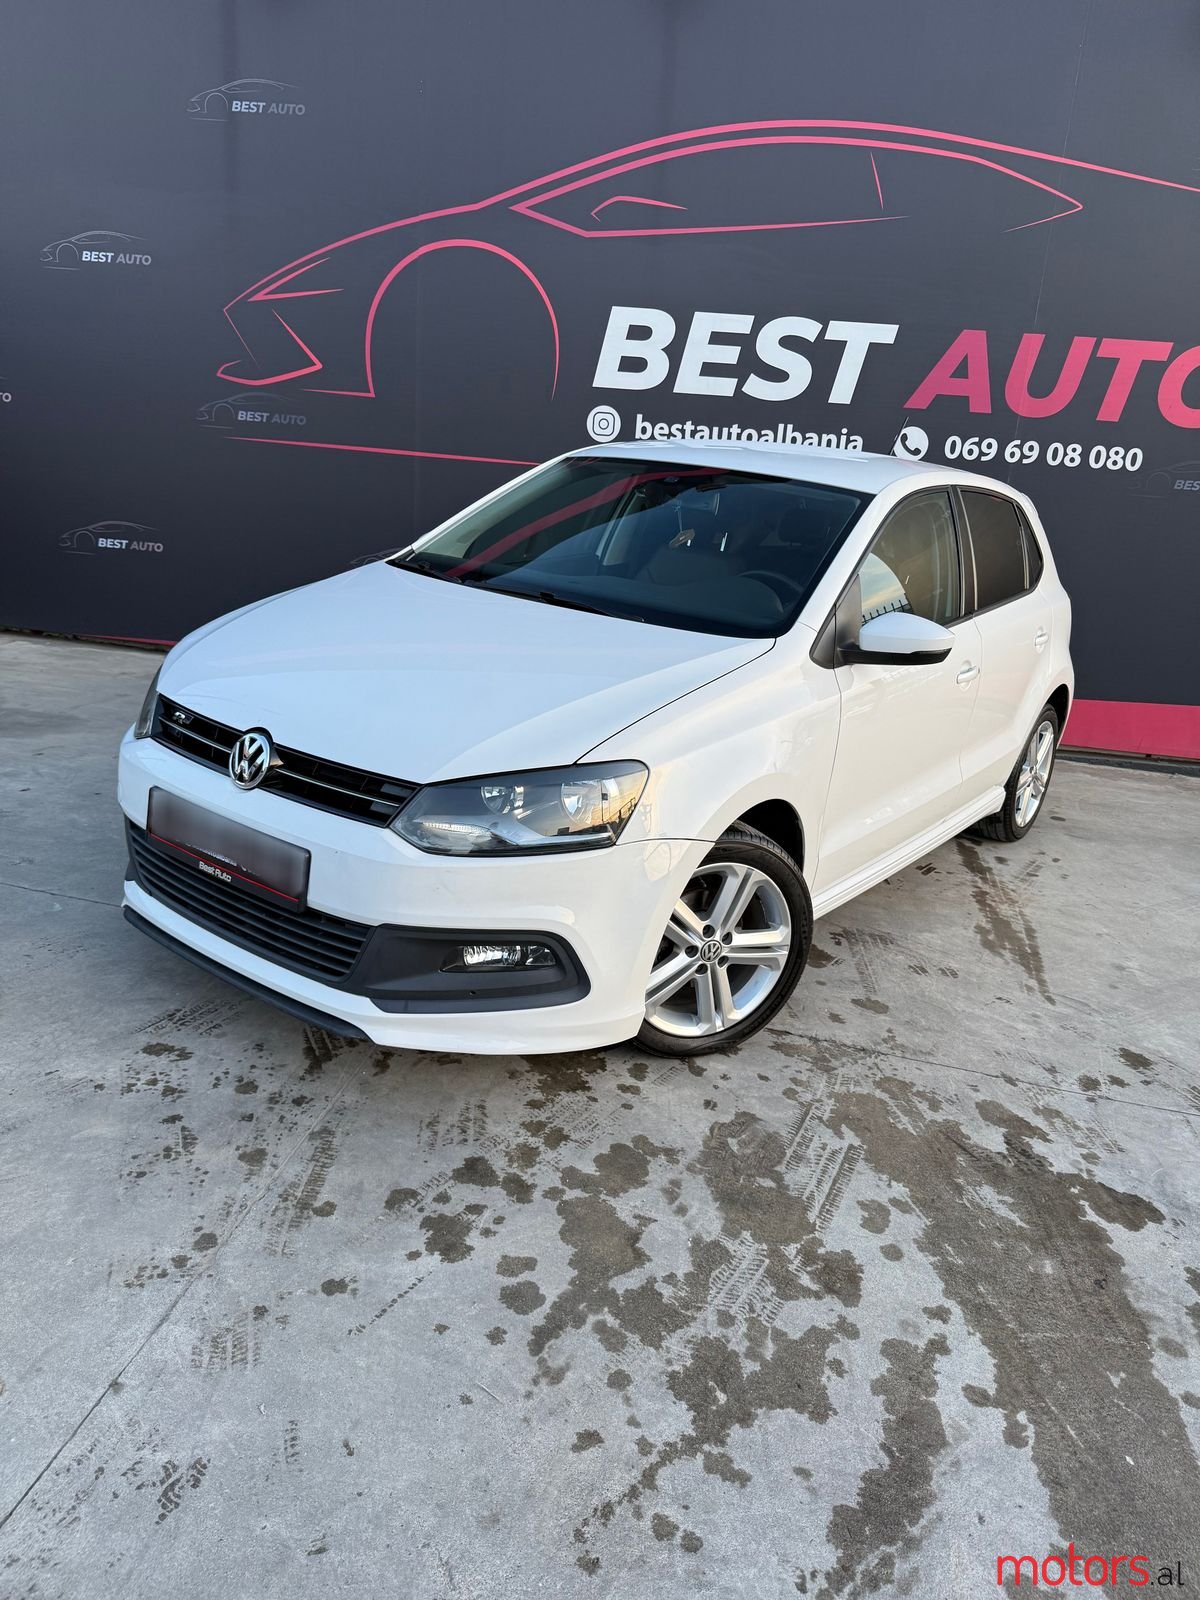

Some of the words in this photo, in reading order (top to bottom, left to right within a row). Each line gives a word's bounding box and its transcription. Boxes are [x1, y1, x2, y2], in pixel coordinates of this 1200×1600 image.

[231, 101, 266, 113] BEST
[268, 103, 306, 116] AUTO
[82, 251, 115, 263] BEST
[116, 253, 152, 266] AUTO
[592, 305, 899, 405] BEST
[237, 411, 270, 423] BEST
[271, 413, 307, 426] AUTO
[634, 413, 864, 453] bestautoalbania
[944, 435, 999, 462] 069
[1004, 439, 1040, 464] 69
[1046, 442, 1083, 467] 08
[1088, 445, 1144, 472] 080
[97, 538, 129, 549] BEST
[130, 541, 164, 552] AUTO
[199, 861, 216, 875] Best
[215, 868, 232, 882] Auto
